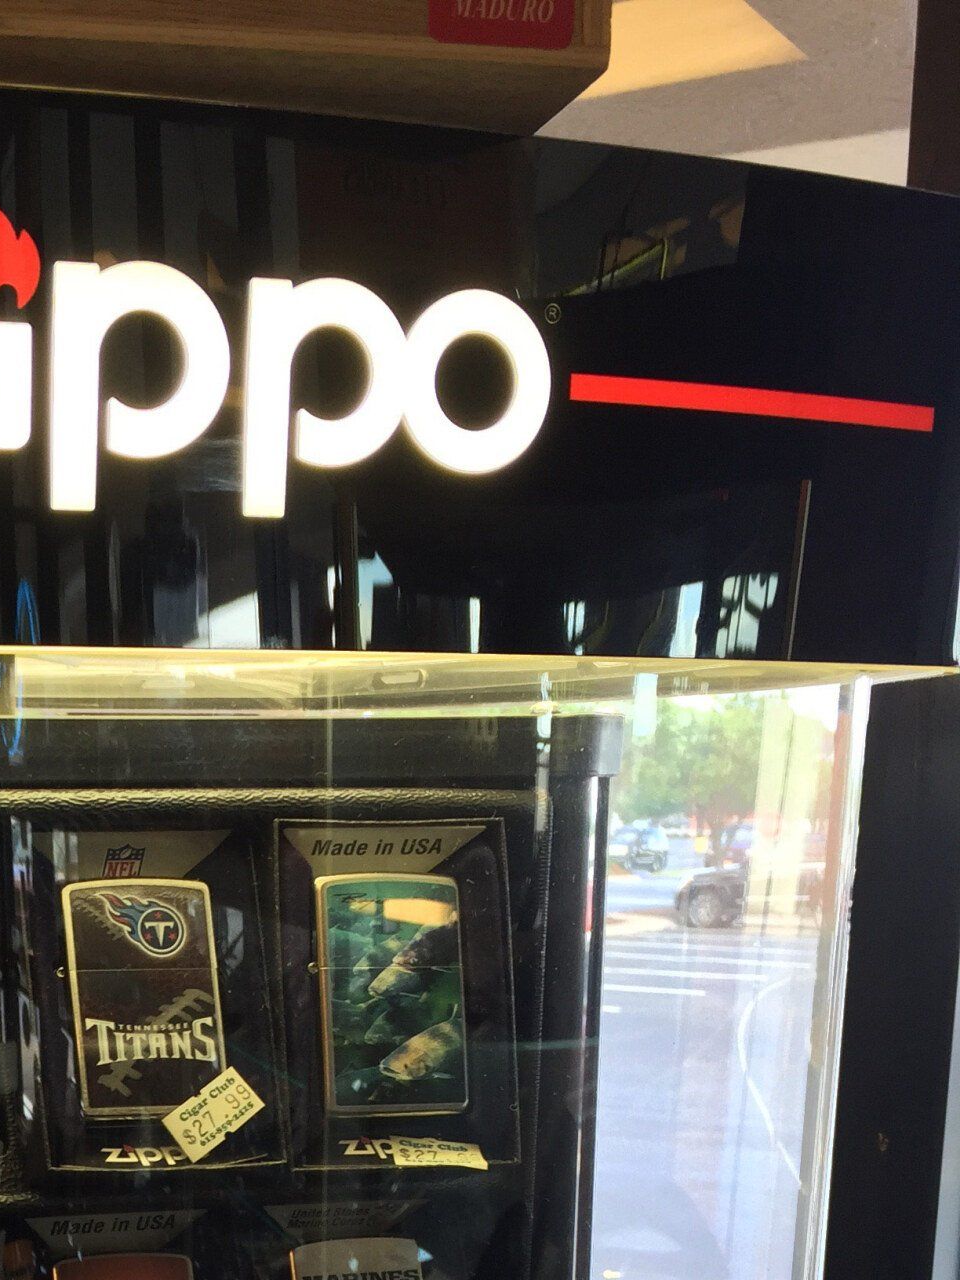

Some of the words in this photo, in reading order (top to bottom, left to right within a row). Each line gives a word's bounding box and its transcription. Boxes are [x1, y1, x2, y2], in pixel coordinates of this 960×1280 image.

[311, 839, 368, 856] Made
[374, 838, 394, 856] in
[400, 838, 442, 855] USA
[180, 1096, 209, 1121] Cigar
[209, 1077, 235, 1098] Club
[101, 1145, 187, 1166] zipp
[437, 1143, 468, 1152] Club
[50, 1219, 105, 1235] Made
[111, 1217, 130, 1232] in
[136, 1214, 176, 1231] USA
